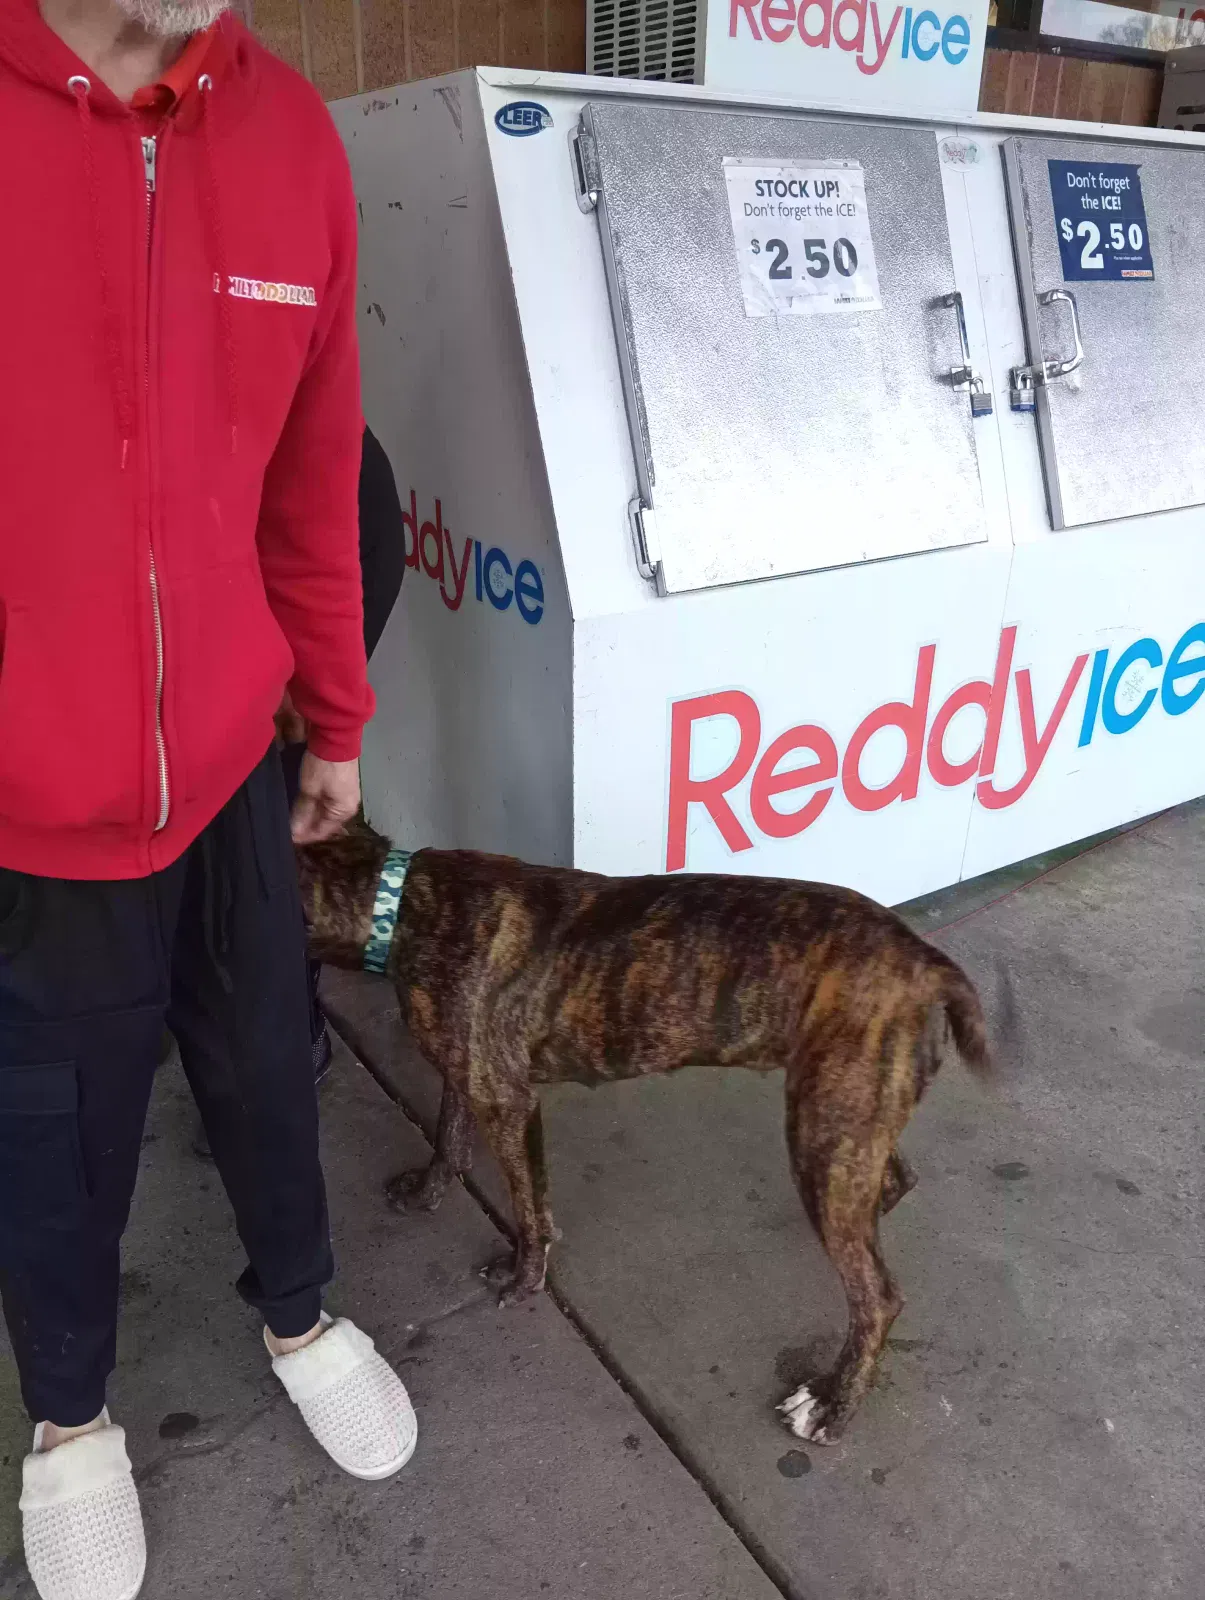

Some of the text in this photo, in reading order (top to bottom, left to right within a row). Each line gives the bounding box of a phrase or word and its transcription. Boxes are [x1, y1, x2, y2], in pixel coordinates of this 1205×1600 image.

[503, 106, 543, 130] LEER
[755, 179, 840, 198] STOCK UP!
[1066, 172, 1131, 194] Don't forget
[1081, 192, 1122, 210] the ICE!
[743, 202, 856, 221] Don't forget the ICE!
